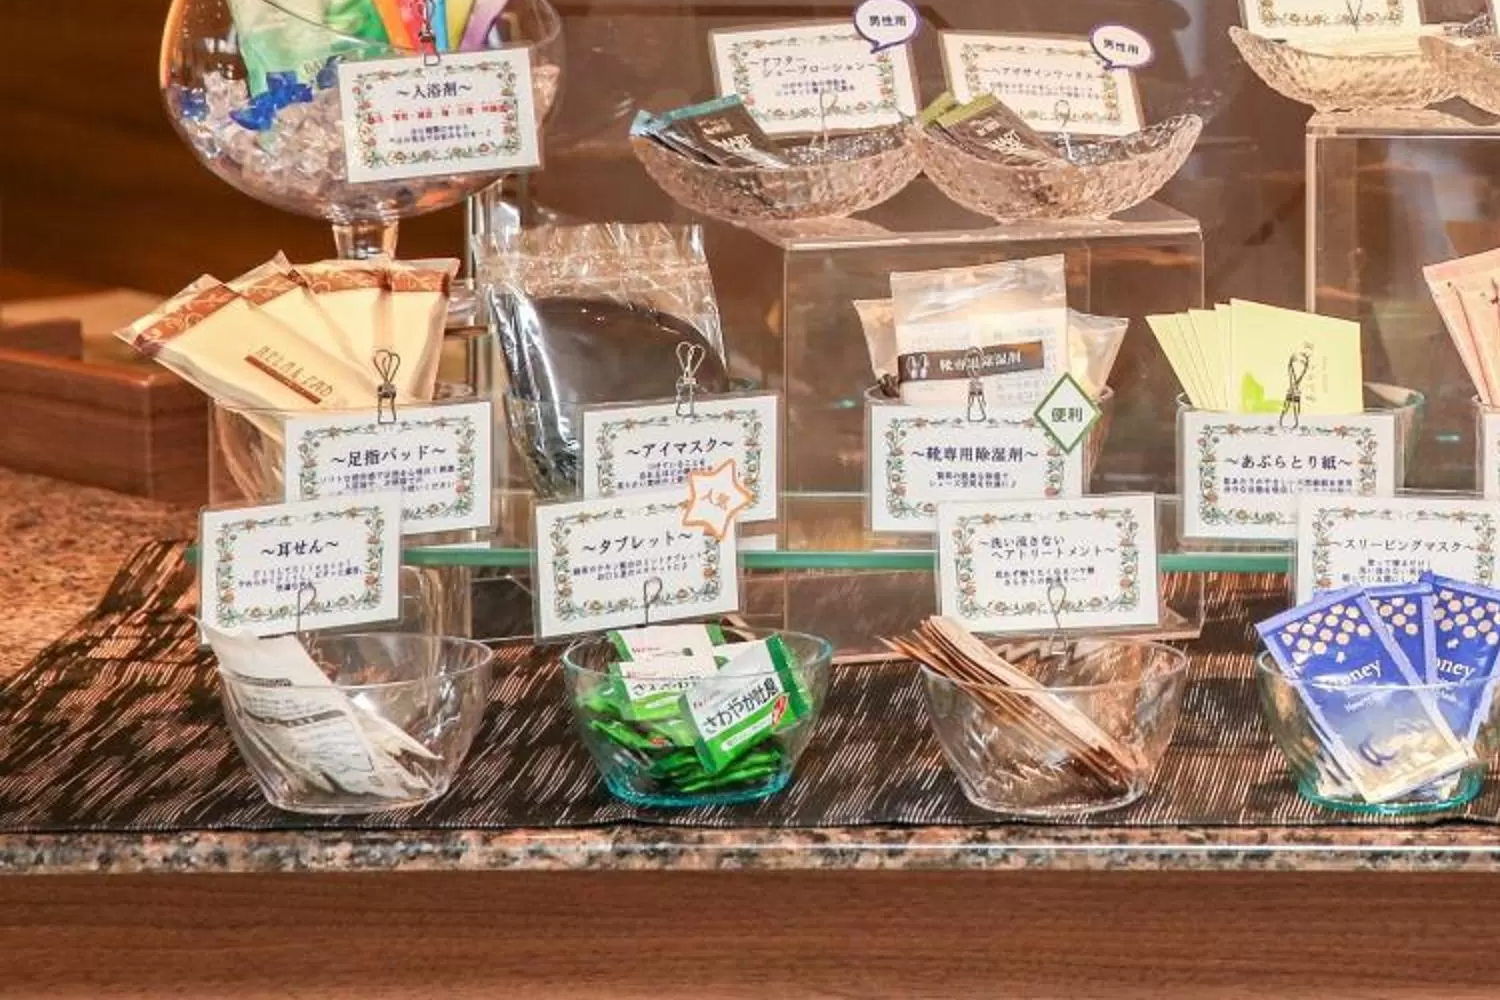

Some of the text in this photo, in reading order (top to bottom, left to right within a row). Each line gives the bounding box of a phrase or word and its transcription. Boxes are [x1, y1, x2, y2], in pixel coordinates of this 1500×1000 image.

[867, 15, 908, 29] 男性用
[1050, 407, 1084, 424] 便利
